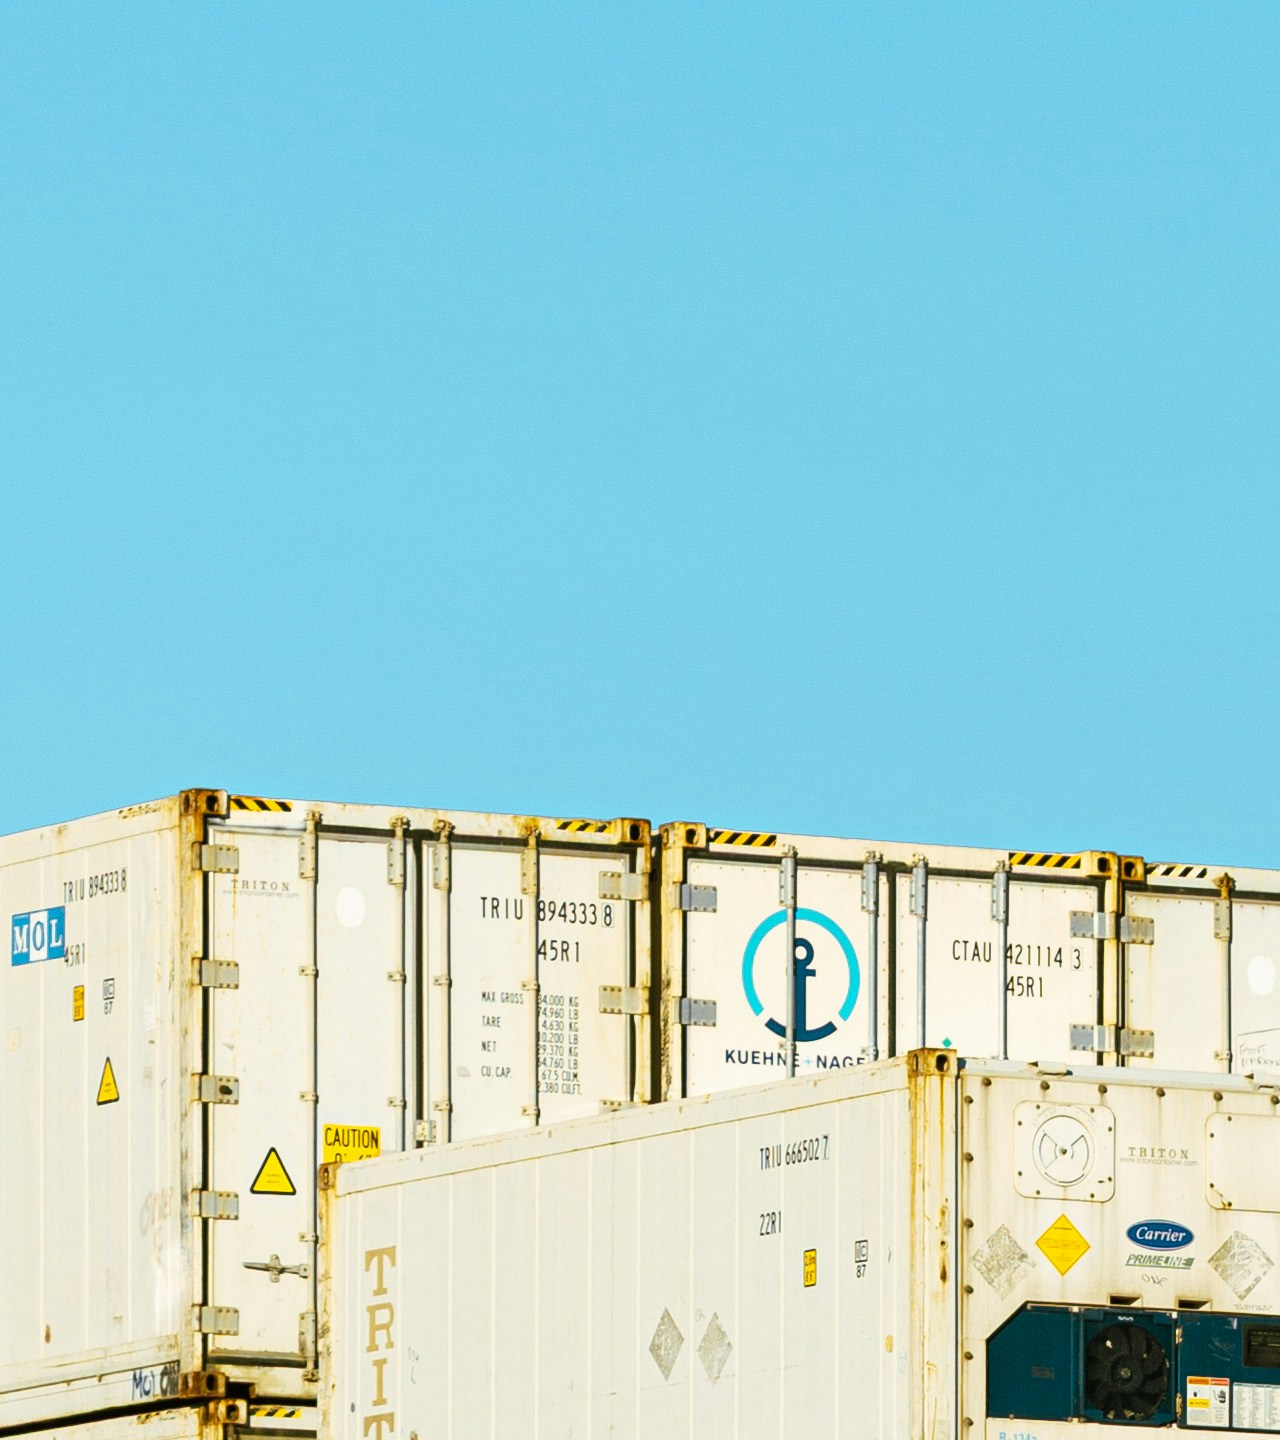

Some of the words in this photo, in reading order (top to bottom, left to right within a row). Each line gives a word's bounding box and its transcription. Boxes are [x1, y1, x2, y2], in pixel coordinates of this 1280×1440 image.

[63, 878, 85, 903] TRIU
[231, 879, 290, 892] TRITON
[480, 896, 523, 920] TRIU
[537, 900, 597, 925] 894333
[14, 918, 63, 954] MOL
[538, 940, 580, 962] 45R1
[952, 939, 993, 962] CTAU
[1005, 944, 1063, 968] 421114
[481, 991, 495, 1002] MAX
[501, 993, 523, 1004] GROSS
[1005, 976, 1044, 998] 45R1
[482, 1015, 501, 1028] TARE
[481, 1041, 497, 1052] NET
[324, 1127, 379, 1149] CAUTION
[759, 1146, 782, 1171] TRIU
[785, 1137, 820, 1167] 666502
[1128, 1146, 1190, 1158] TRITON
[759, 1211, 783, 1236] 22R1
[1135, 1225, 1187, 1243] Carrier
